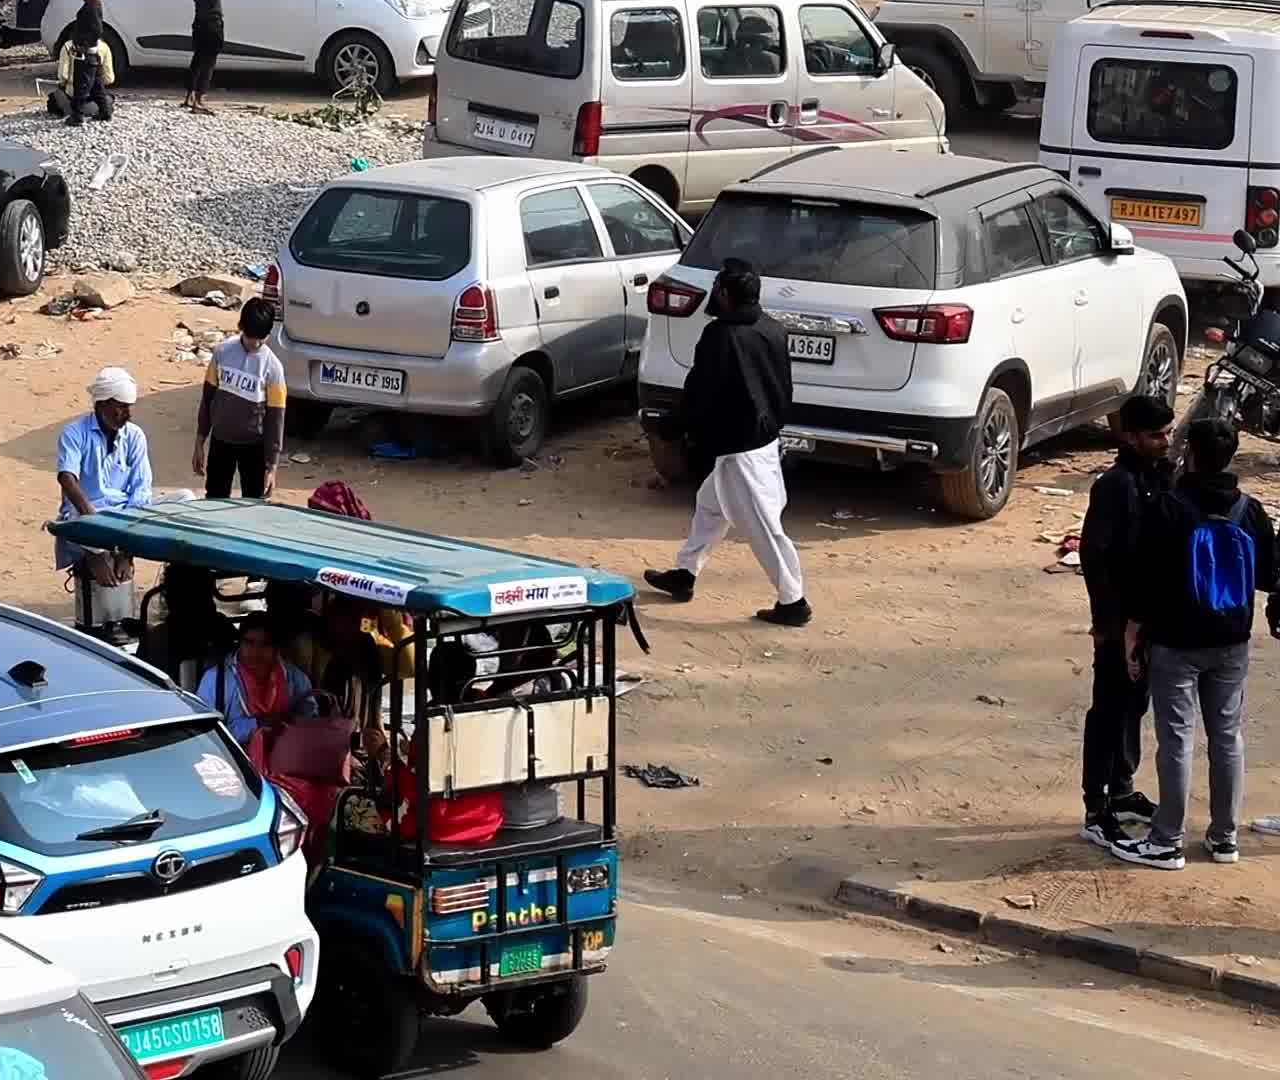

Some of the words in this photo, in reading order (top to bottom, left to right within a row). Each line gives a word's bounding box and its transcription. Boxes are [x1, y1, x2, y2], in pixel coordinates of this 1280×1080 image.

[500, 127, 506, 138] U
[335, 369, 348, 383] RJ
[351, 371, 362, 384] 14
[364, 374, 380, 387] CF
[382, 376, 400, 391] 1913
[142, 923, 203, 944] NEXON
